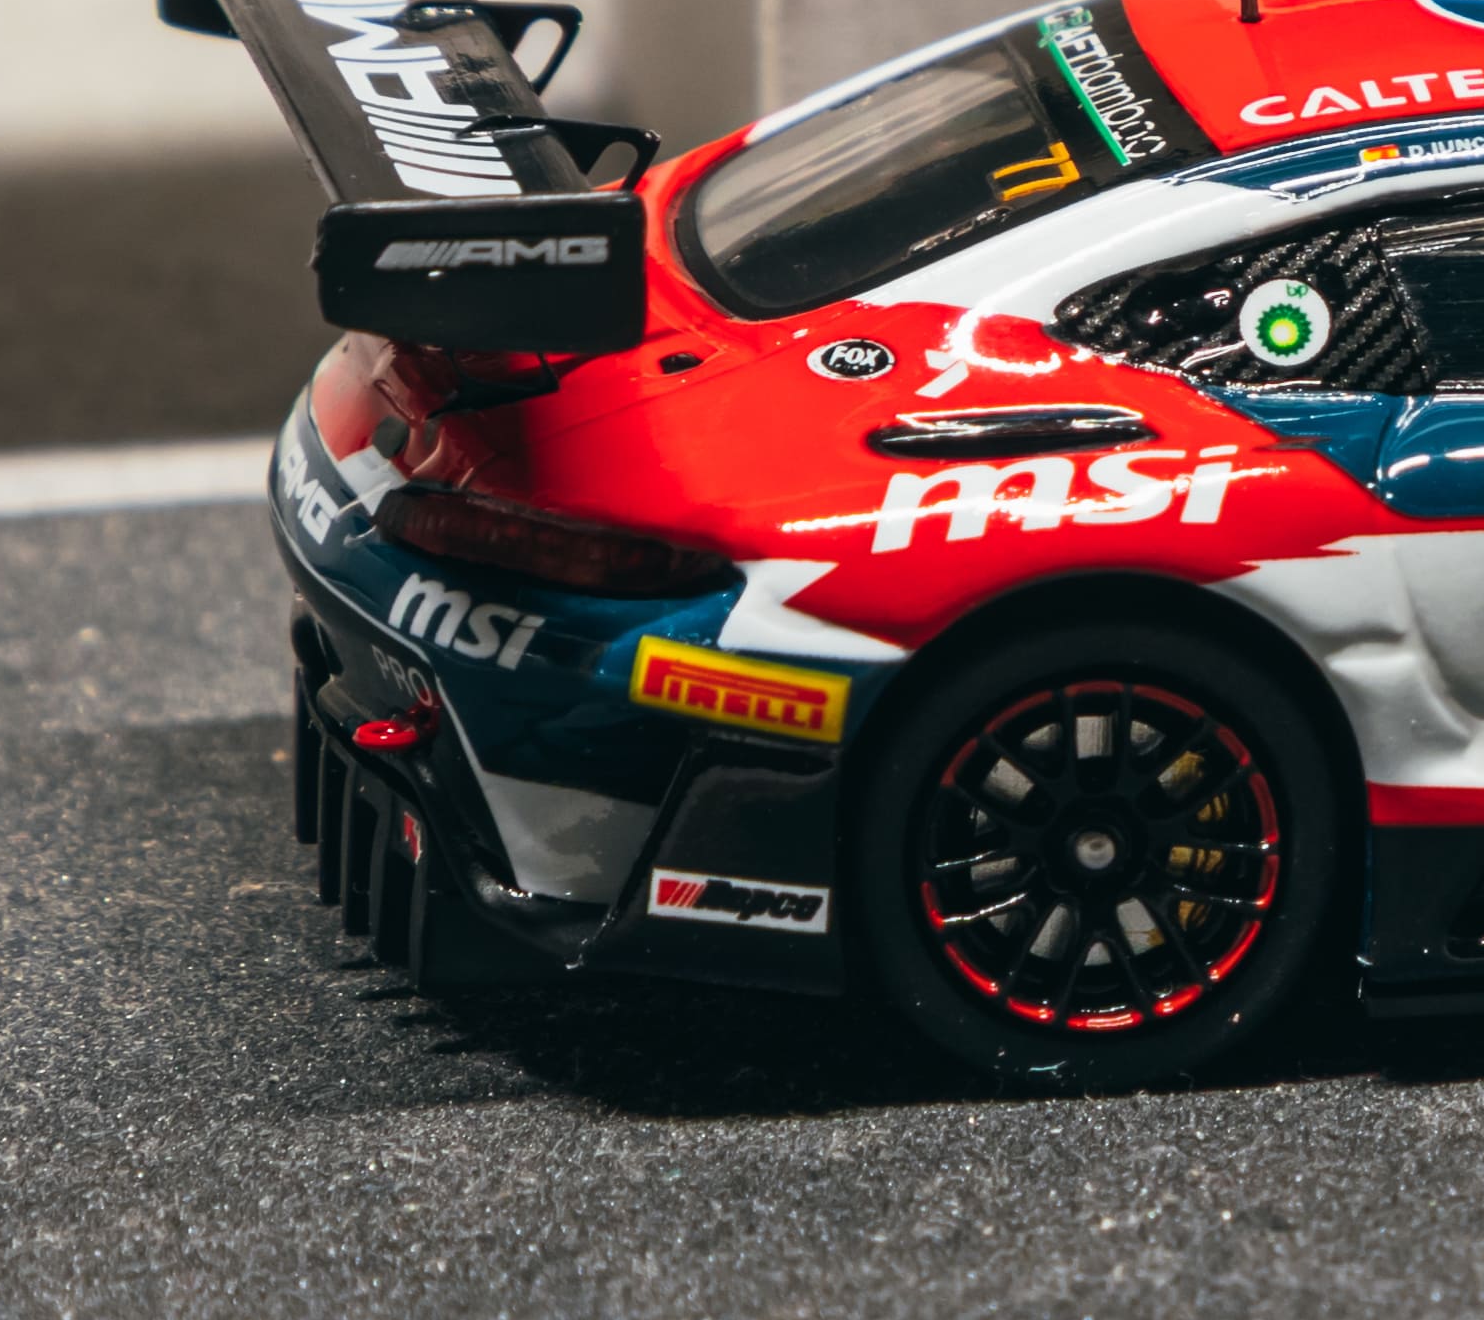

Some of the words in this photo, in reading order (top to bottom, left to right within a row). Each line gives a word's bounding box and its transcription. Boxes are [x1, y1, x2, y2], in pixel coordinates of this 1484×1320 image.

[993, 141, 1080, 201] 77
[458, 236, 610, 267] AMG
[1285, 283, 1309, 299] bp
[828, 345, 881, 367] FOX
[278, 445, 341, 546] AMG
[871, 446, 1238, 554] msi
[387, 572, 547, 671] msi
[371, 644, 435, 708] PRO
[642, 655, 829, 732] PIRELLI
[693, 879, 824, 922] Repco
